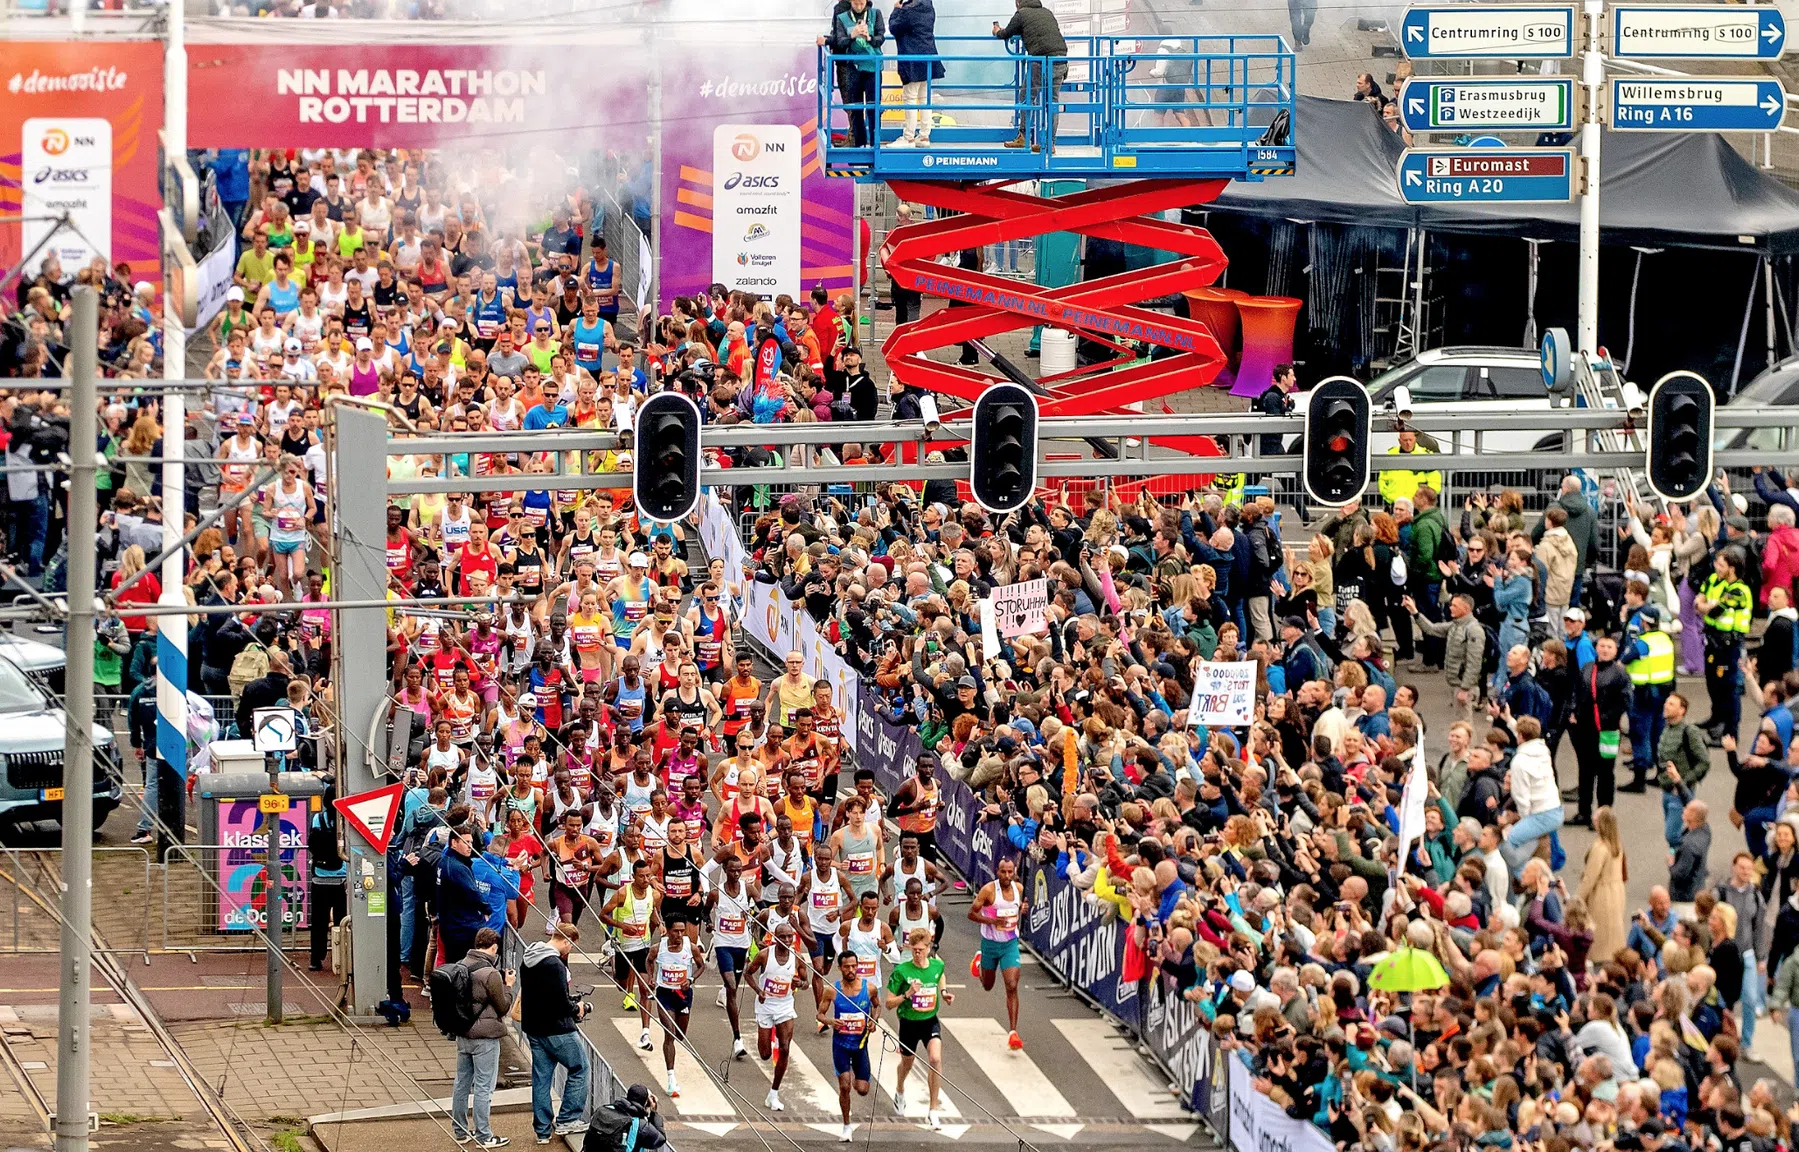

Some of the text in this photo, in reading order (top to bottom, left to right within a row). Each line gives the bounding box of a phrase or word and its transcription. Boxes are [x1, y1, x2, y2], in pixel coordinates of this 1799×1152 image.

[1431, 26, 1561, 41] Centrumring S 100
[1623, 26, 1752, 41] Centrumring S 100
[8, 66, 128, 93] #demooiste
[277, 68, 546, 95] NN MARATHON
[700, 72, 818, 98] #demooiste
[1459, 90, 1546, 103] Erasmusbrug
[1622, 86, 1723, 102] Willemsbrug
[299, 96, 525, 123] ROTTERDAM
[1459, 108, 1541, 121] Westzeedijk
[1617, 107, 1654, 124] Ring
[74, 137, 95, 146] NN
[765, 143, 785, 152] NN
[935, 156, 998, 166] PEINEMANN
[1256, 150, 1278, 160] 1584
[1453, 158, 1530, 172] Euromast
[742, 176, 780, 188] asics
[1426, 179, 1462, 197] Ring
[736, 204, 778, 215] amazfit
[735, 276, 777, 286] zalando
[915, 275, 1048, 316] PEINEMANN.NL
[1061, 308, 1197, 349] PEINEMANN.NL
[446, 526, 468, 535] USA
[223, 829, 303, 846] klassek
